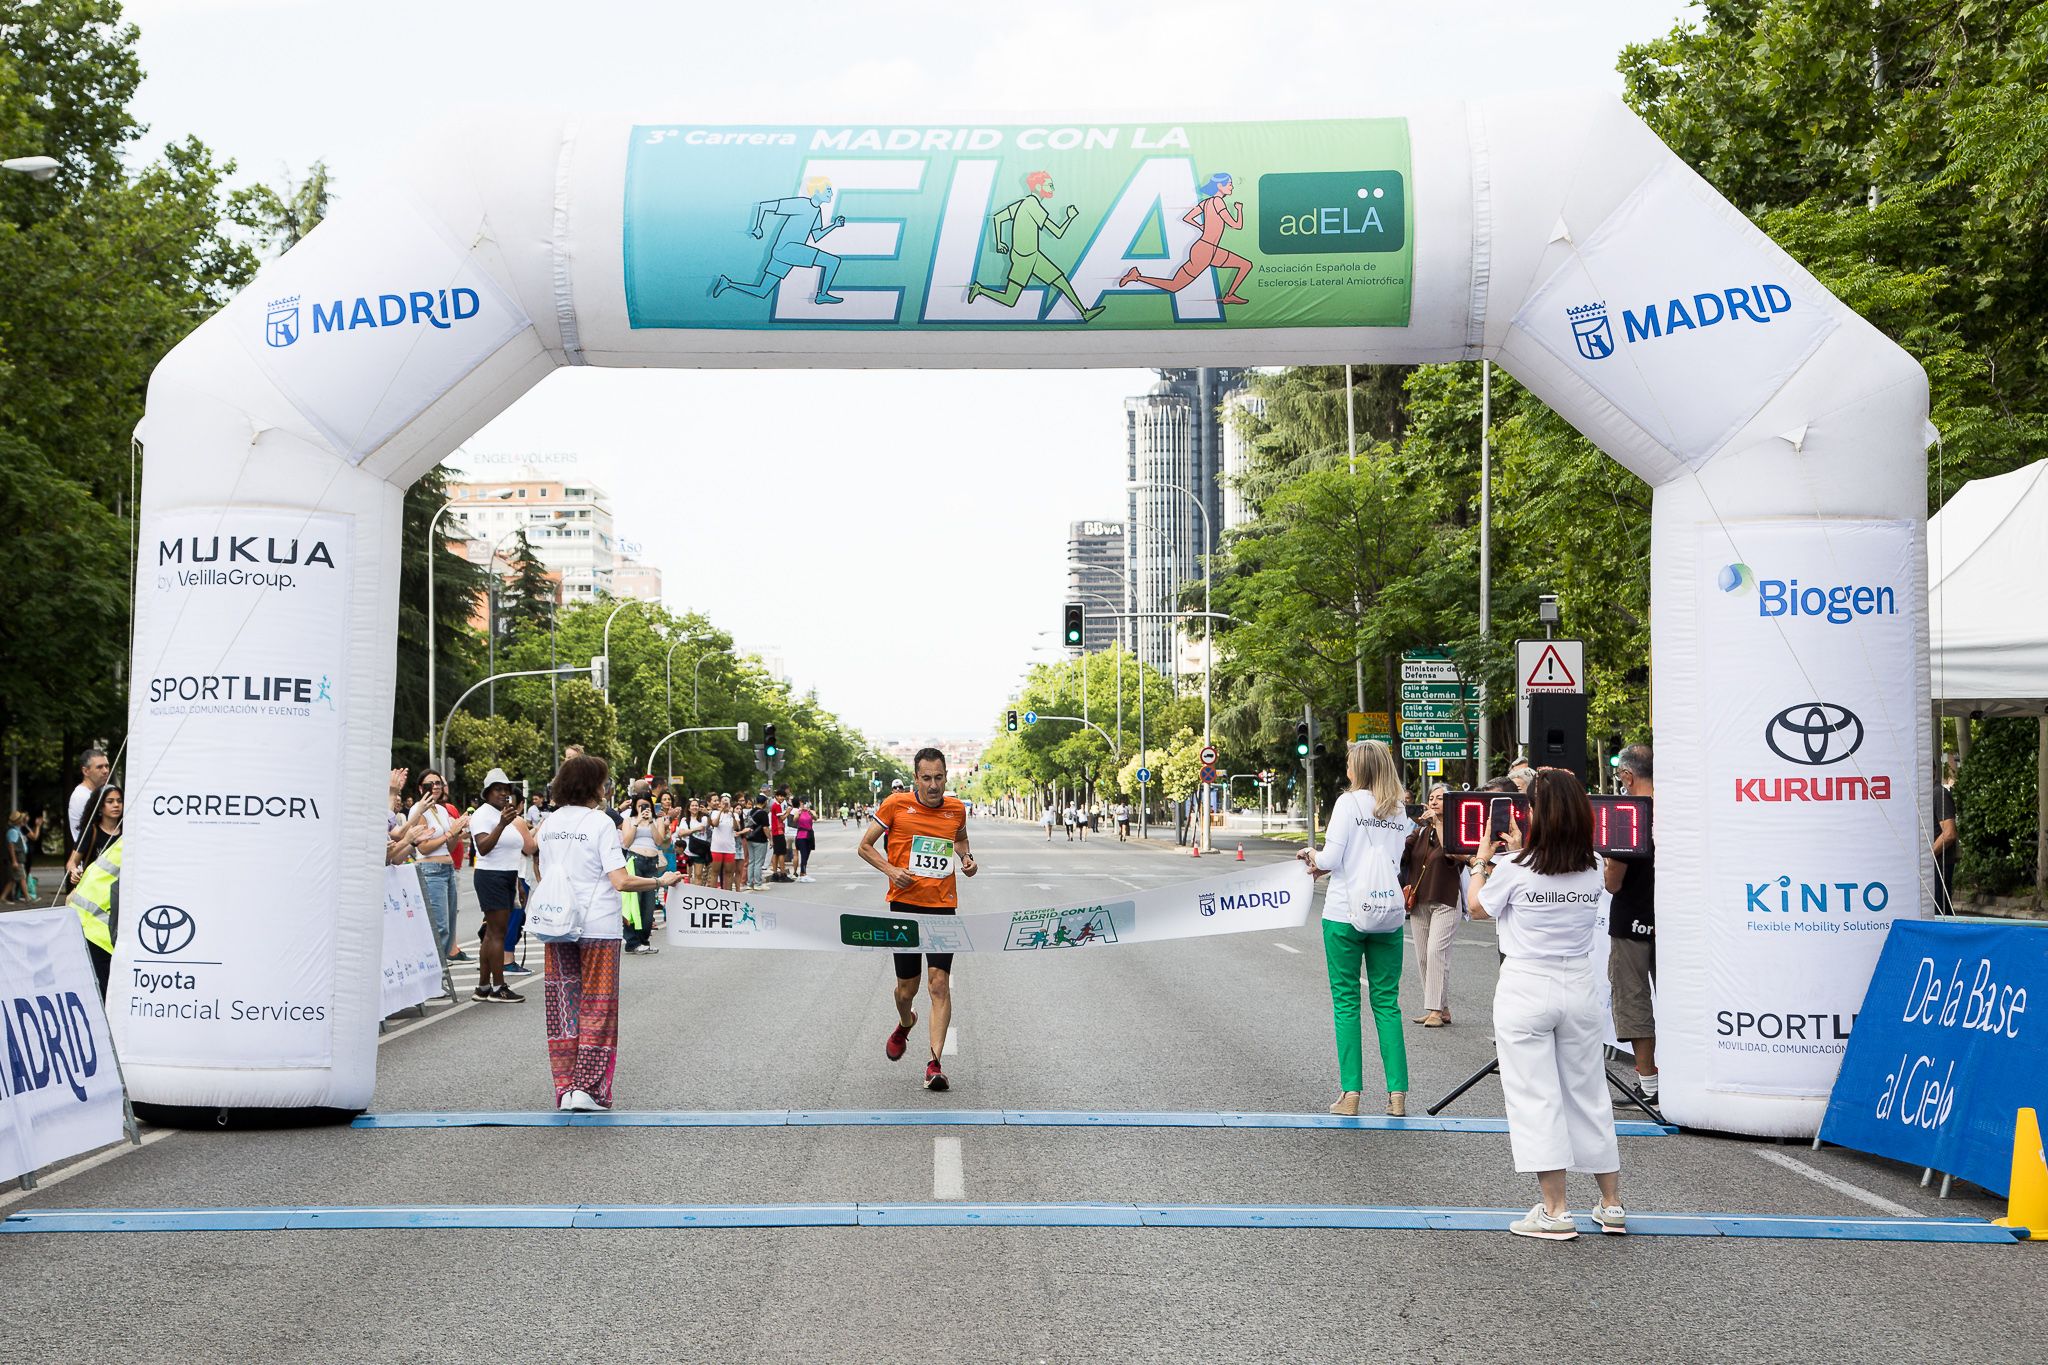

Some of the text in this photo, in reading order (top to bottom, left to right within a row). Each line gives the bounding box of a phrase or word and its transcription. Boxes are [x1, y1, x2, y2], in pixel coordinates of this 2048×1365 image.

[684, 130, 797, 145] Carrera
[809, 128, 1003, 150] MADRID
[1016, 128, 1119, 150] CON
[1130, 127, 1190, 149] LA
[1279, 206, 1384, 236] adELA
[769, 155, 1228, 325] ELA
[1258, 262, 1377, 274] Asociación Española de
[1257, 276, 1404, 288] Esclerosis Lateral Amiotrófica
[312, 287, 480, 334] MADRID
[1622, 284, 1792, 343] MADRID
[1084, 522, 1121, 536] BBVA
[160, 536, 335, 568] MUKUA
[1422, 691, 1456, 699] Germán
[1405, 710, 1435, 718] Alberto
[920, 841, 947, 854] ELA
[915, 855, 948, 870] 1319
[682, 896, 740, 911] SPORT
[1220, 890, 1291, 911] MADRID
[1012, 911, 1057, 921] MADRID
[1061, 908, 1085, 916] CON
[1024, 907, 1055, 915] Carrera
[690, 912, 733, 928] LIFE
[1747, 921, 1889, 933] Flexible Mobility Solutions
[852, 929, 908, 942] adELA
[134, 968, 196, 994] Toyota
[1903, 957, 2027, 1039] De la Base
[130, 997, 325, 1021] Financial Services
[1876, 1053, 1908, 1120] al
